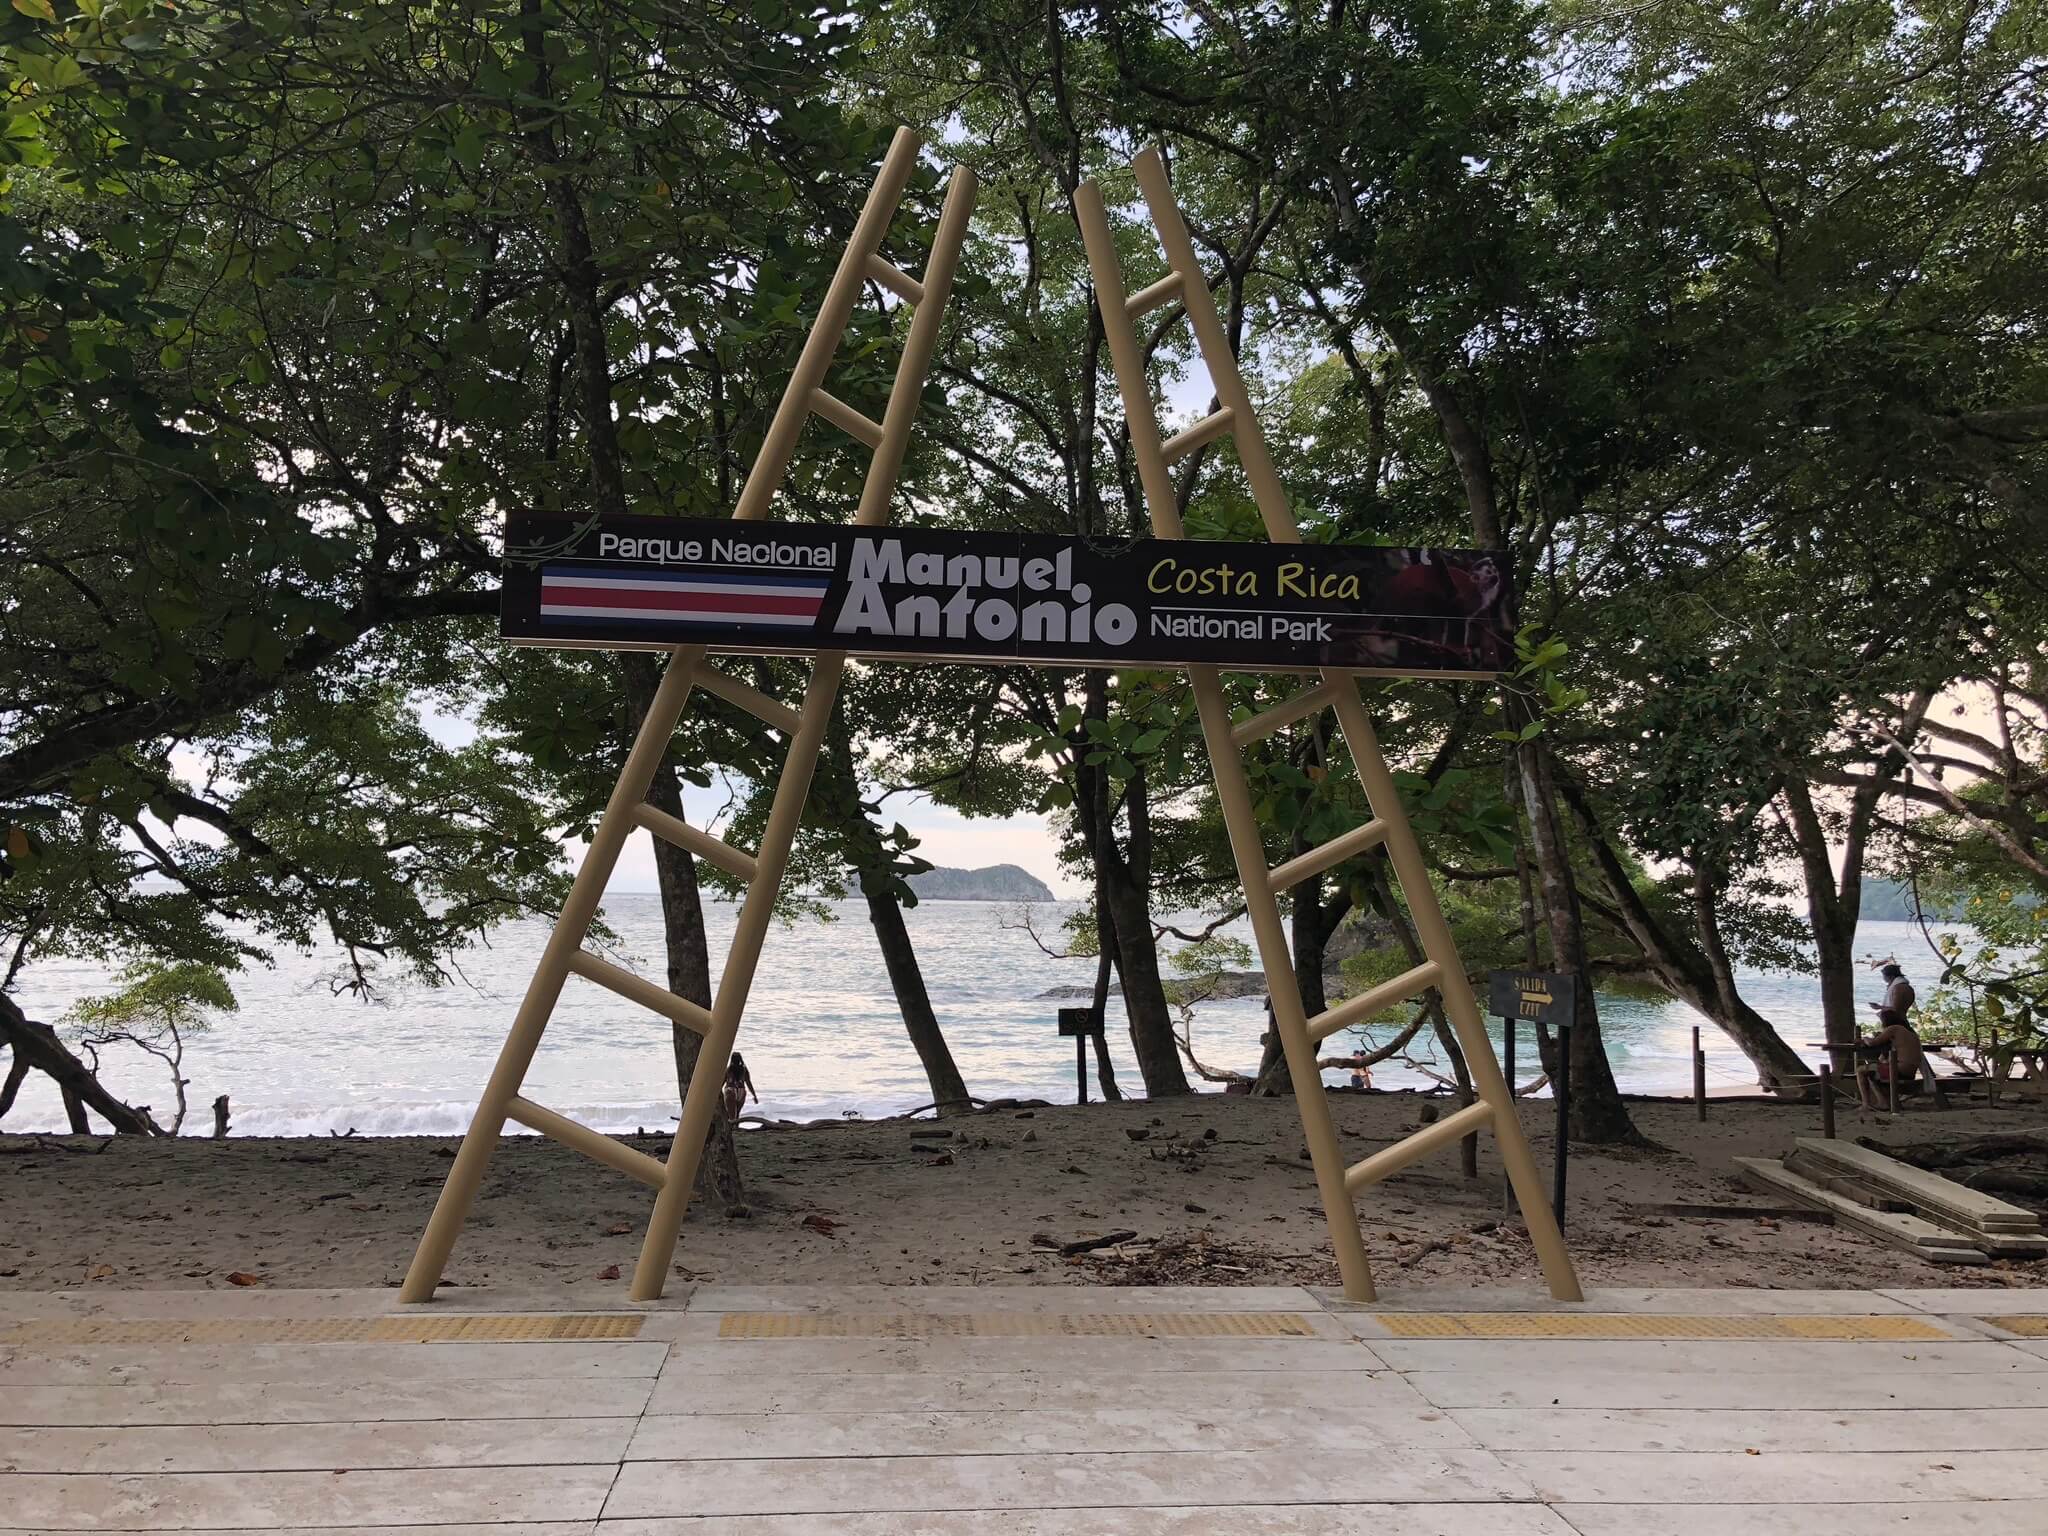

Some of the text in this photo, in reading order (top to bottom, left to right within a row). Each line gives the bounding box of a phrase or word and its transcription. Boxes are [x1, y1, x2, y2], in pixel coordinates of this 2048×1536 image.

[600, 533, 837, 567] Parque Nacional
[847, 538, 1072, 591] Manuel
[1147, 558, 1361, 600] Costa Rica
[833, 583, 1138, 646] Antonio
[1150, 614, 1333, 643] National Park
[1514, 977, 1547, 992] SALIDA
